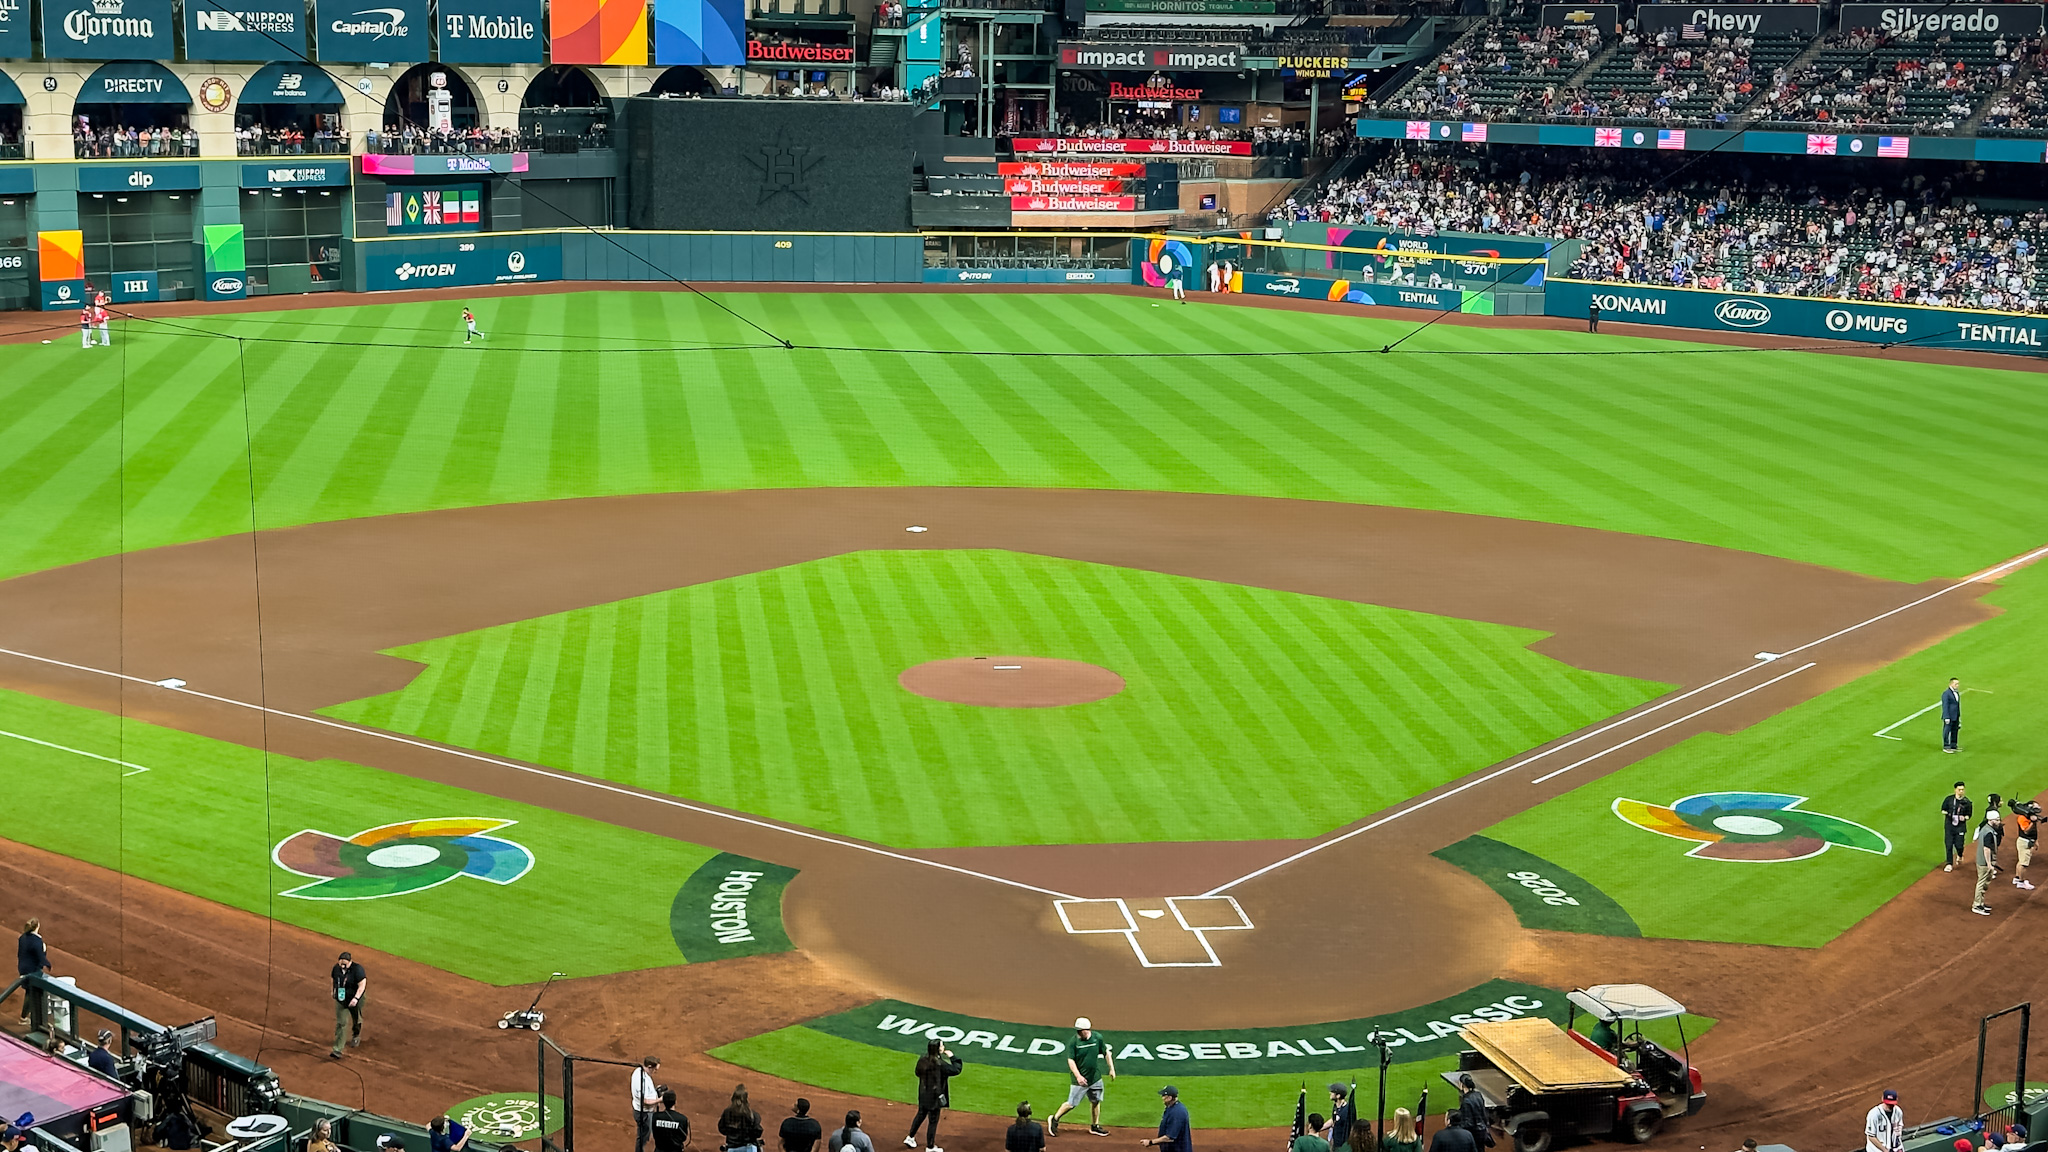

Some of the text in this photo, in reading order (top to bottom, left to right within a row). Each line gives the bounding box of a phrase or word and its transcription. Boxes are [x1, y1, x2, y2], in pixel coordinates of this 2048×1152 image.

[1151, 1, 1206, 12] HORNITOS
[246, 12, 294, 22] NIPPON
[1691, 9, 1762, 34] Chevy
[1880, 8, 2000, 32] Silverado
[64, 9, 154, 44] Corona
[246, 23, 295, 33] EXPRESS
[469, 15, 533, 39] Mobile
[747, 40, 854, 61] Budweiser
[1077, 48, 1237, 69] impact impact
[1278, 56, 1349, 69] PLUCKERS
[105, 78, 163, 93] DIRECTV
[360, 82, 371, 90] DK
[1109, 81, 1204, 99] Budweiser
[1057, 139, 1232, 154] Budweiser Budweiser
[458, 158, 491, 171] Mobile
[1041, 163, 1114, 177] Budweiser
[128, 171, 153, 189] dip
[1031, 180, 1105, 194] Budweiser
[1048, 196, 1120, 210] Budweiser
[459, 243, 475, 251] 399
[775, 240, 792, 249] 409
[1399, 240, 1428, 249] WORLD
[415, 263, 456, 278] ITO EN
[1464, 265, 1488, 275] 370
[124, 280, 148, 293] IHI
[215, 279, 242, 292] Kowa
[1398, 291, 1439, 304] TENTIAL
[1592, 293, 1667, 315] KONAMI
[1720, 303, 1768, 322] Kowa
[1856, 315, 1908, 334] MUFG
[1957, 322, 2042, 346] TENTIAL
[1506, 871, 1581, 906] 2026
[709, 870, 764, 944] HOUSTON
[876, 1014, 1065, 1056] WORLD
[1366, 994, 1544, 1048] CLASSIC
[655, 1119, 680, 1130] SECURITY
